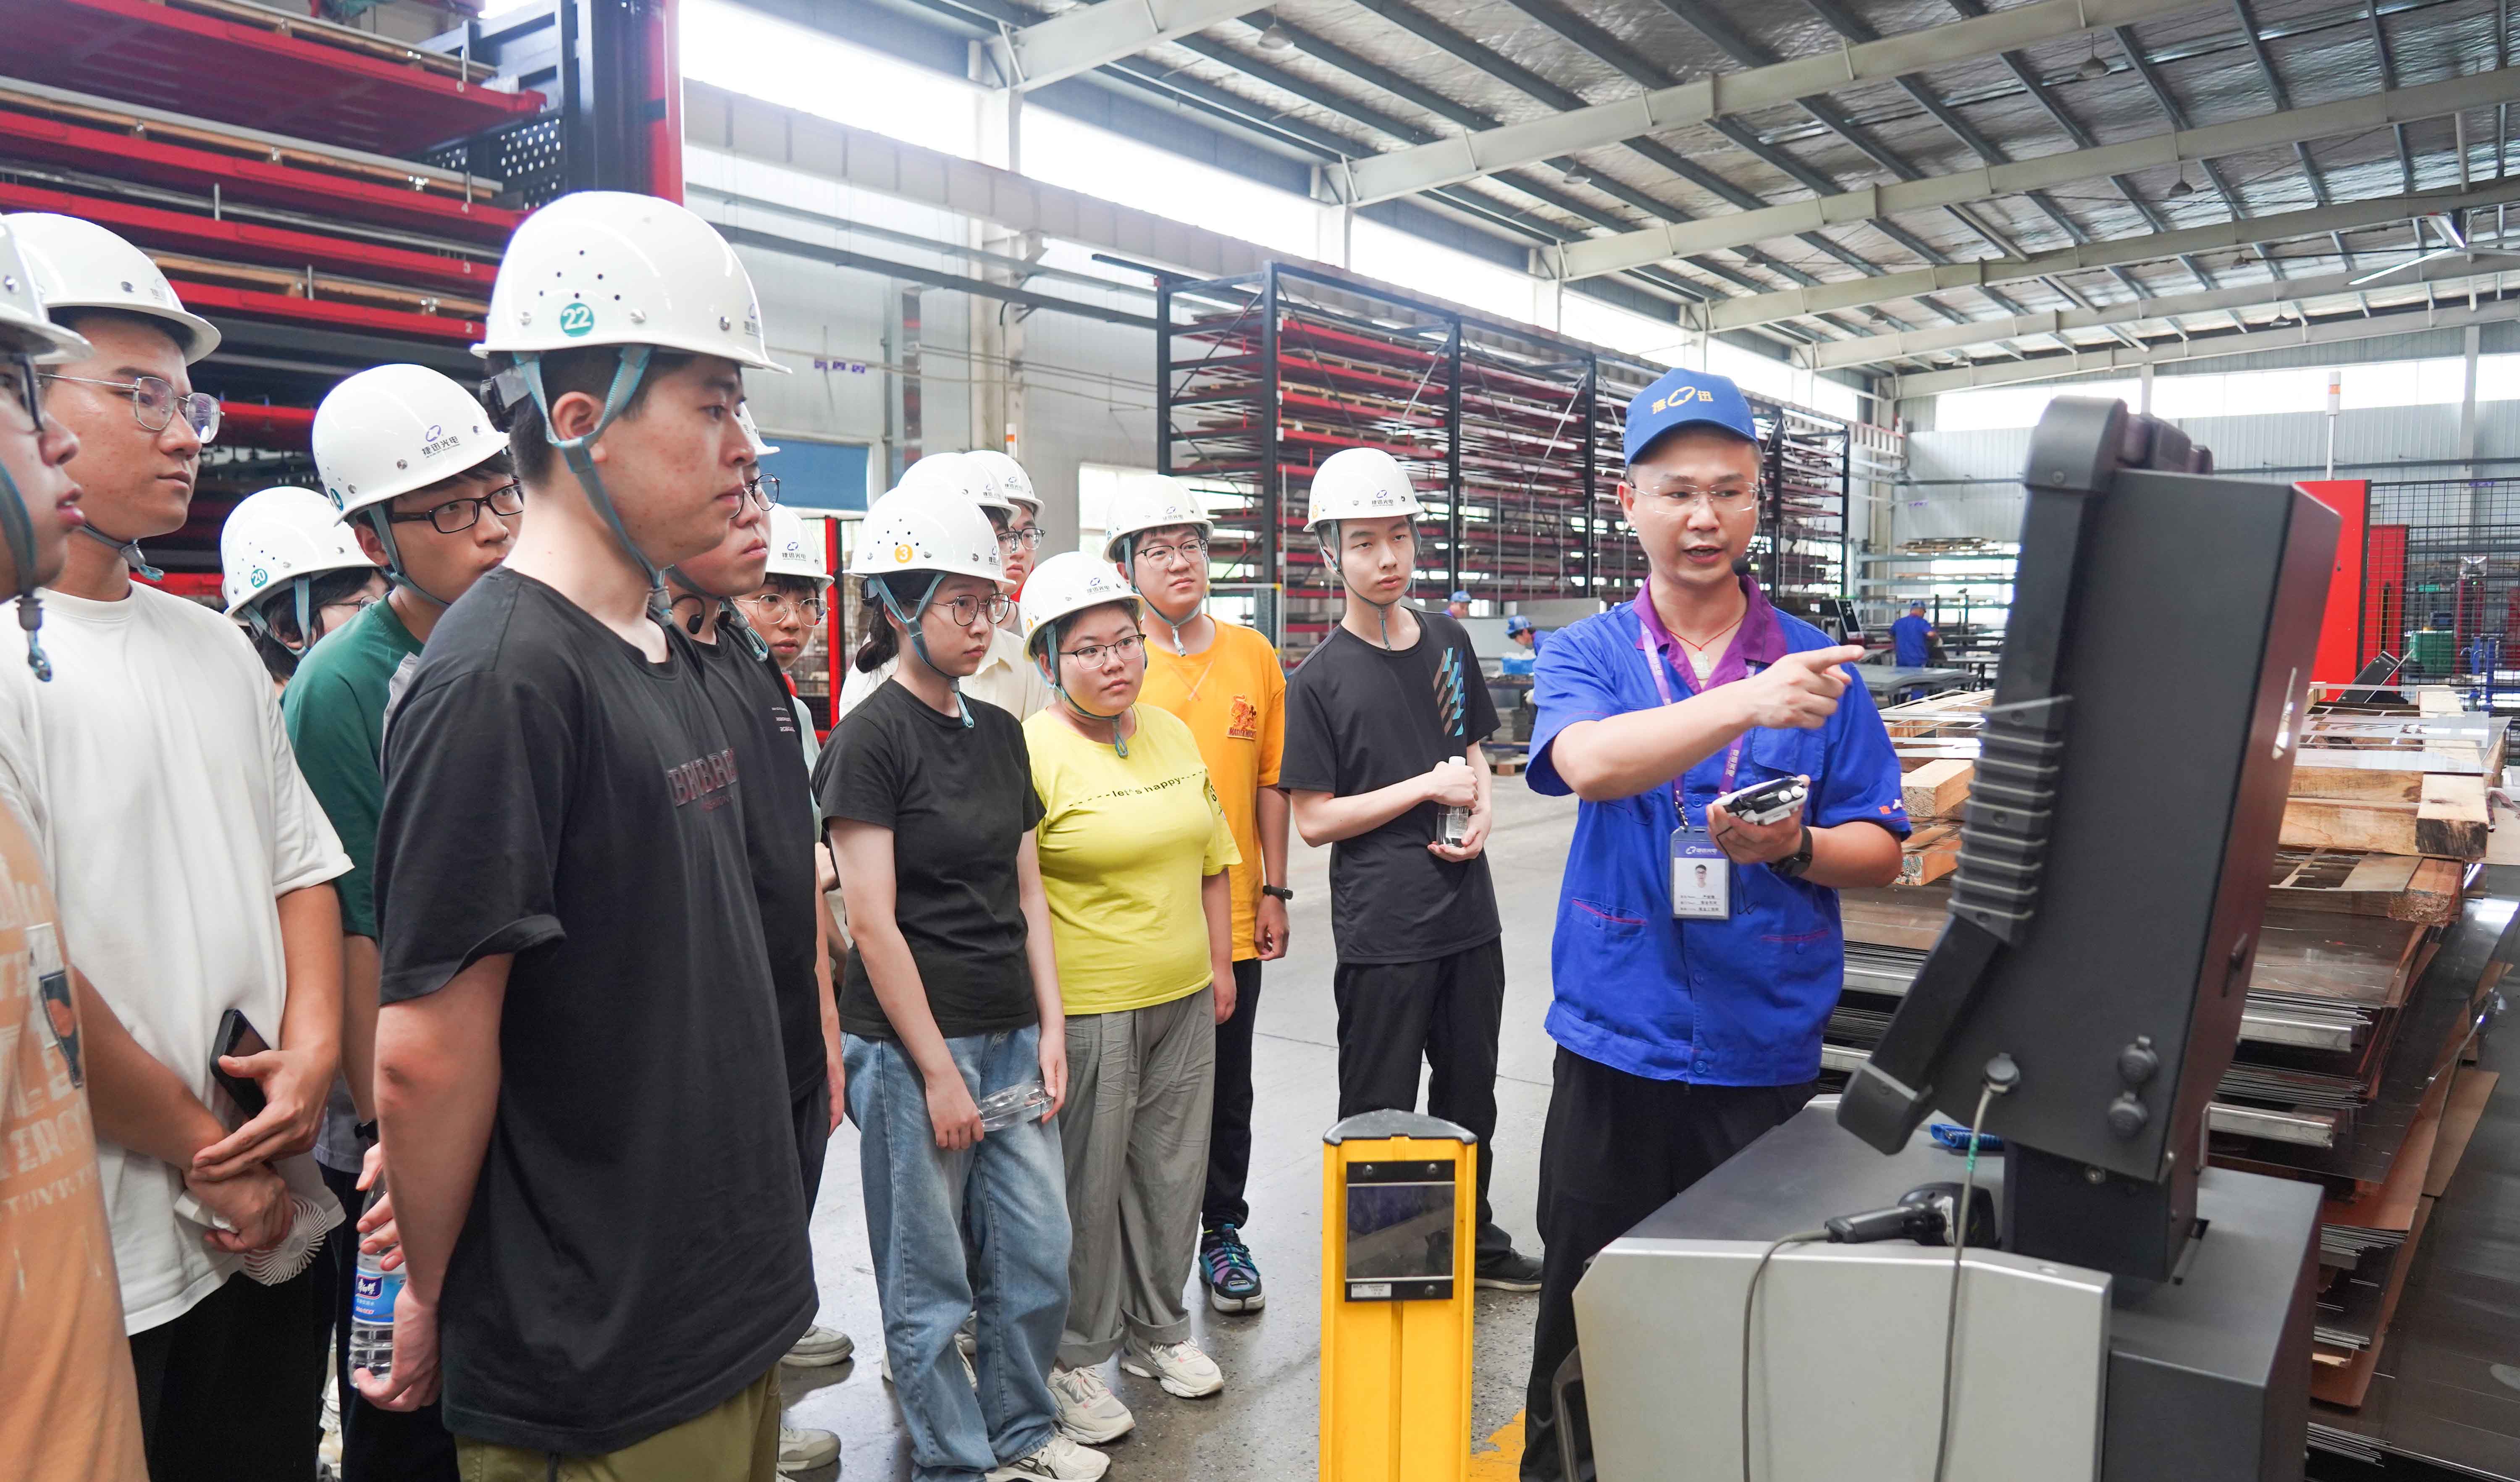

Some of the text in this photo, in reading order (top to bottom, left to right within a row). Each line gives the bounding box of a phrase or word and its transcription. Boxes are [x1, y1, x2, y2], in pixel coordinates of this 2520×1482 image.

[461, 203, 469, 214] 4
[463, 261, 471, 273] 3
[563, 306, 592, 330] 22
[465, 322, 473, 334] 2
[1696, 390, 1714, 402] 迅
[899, 547, 908, 560] 3
[252, 569, 266, 585] 20
[1112, 777, 1181, 797] let's happy
